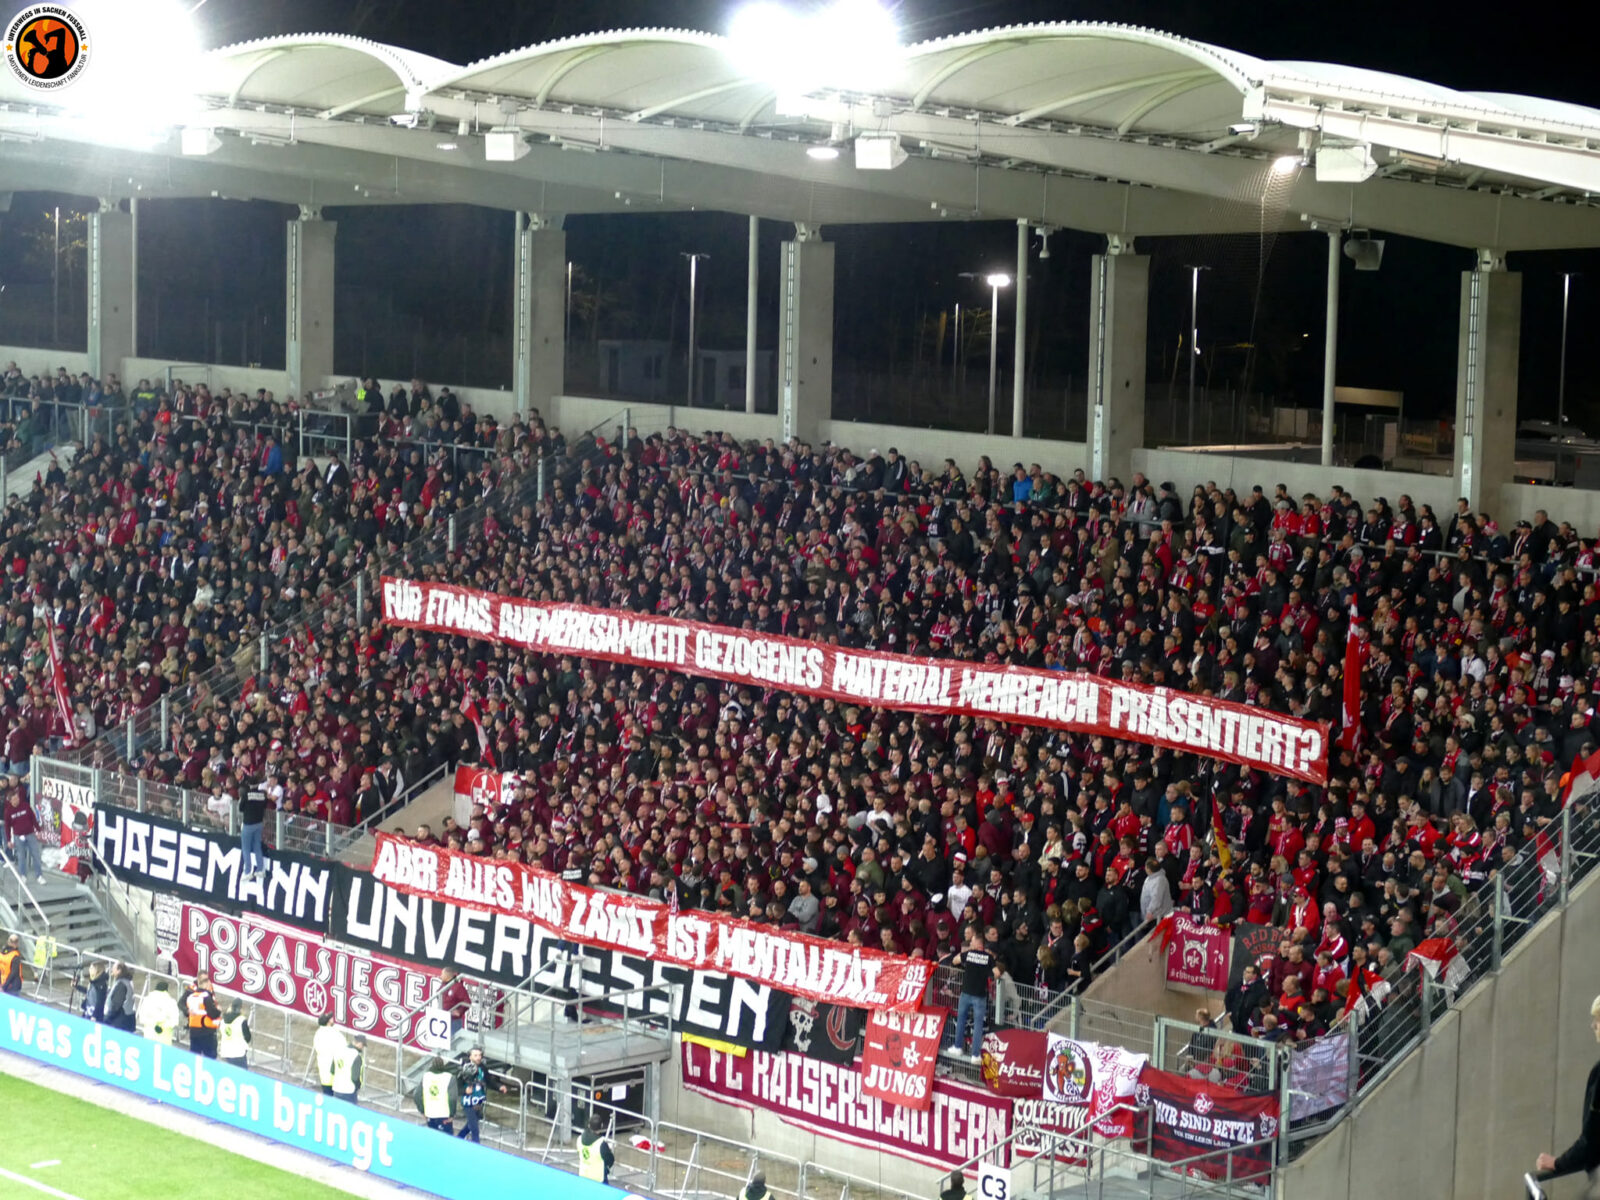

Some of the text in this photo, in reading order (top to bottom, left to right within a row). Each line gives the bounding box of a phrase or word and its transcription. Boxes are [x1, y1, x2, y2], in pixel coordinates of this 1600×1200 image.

[384, 579, 1322, 772] FÜR ETWAS AUFMERKSAMKEIT GEZOGENES MATERIAL MEHRFACH PRÄSENTIERT?
[97, 810, 330, 923] HASEMANN
[371, 841, 438, 892] ABER
[444, 856, 515, 910] ALLES
[521, 872, 563, 927] WAS
[568, 890, 659, 958] ZÄHLT,
[666, 913, 712, 965] IST
[194, 941, 296, 1006] 1990
[346, 876, 771, 1042] UNVERGESSEN
[429, 1017, 448, 1040] C2
[871, 1010, 941, 1040] BETZE
[8, 1008, 394, 1172] was das Leben bringt
[752, 1050, 1007, 1168] KAISERSLAUTERN
[864, 1064, 927, 1099] JUNGS
[1153, 1099, 1178, 1127] WIR
[1179, 1110, 1212, 1133] SIND
[1213, 1118, 1255, 1145] BETZE
[982, 1174, 1006, 1200] C3
